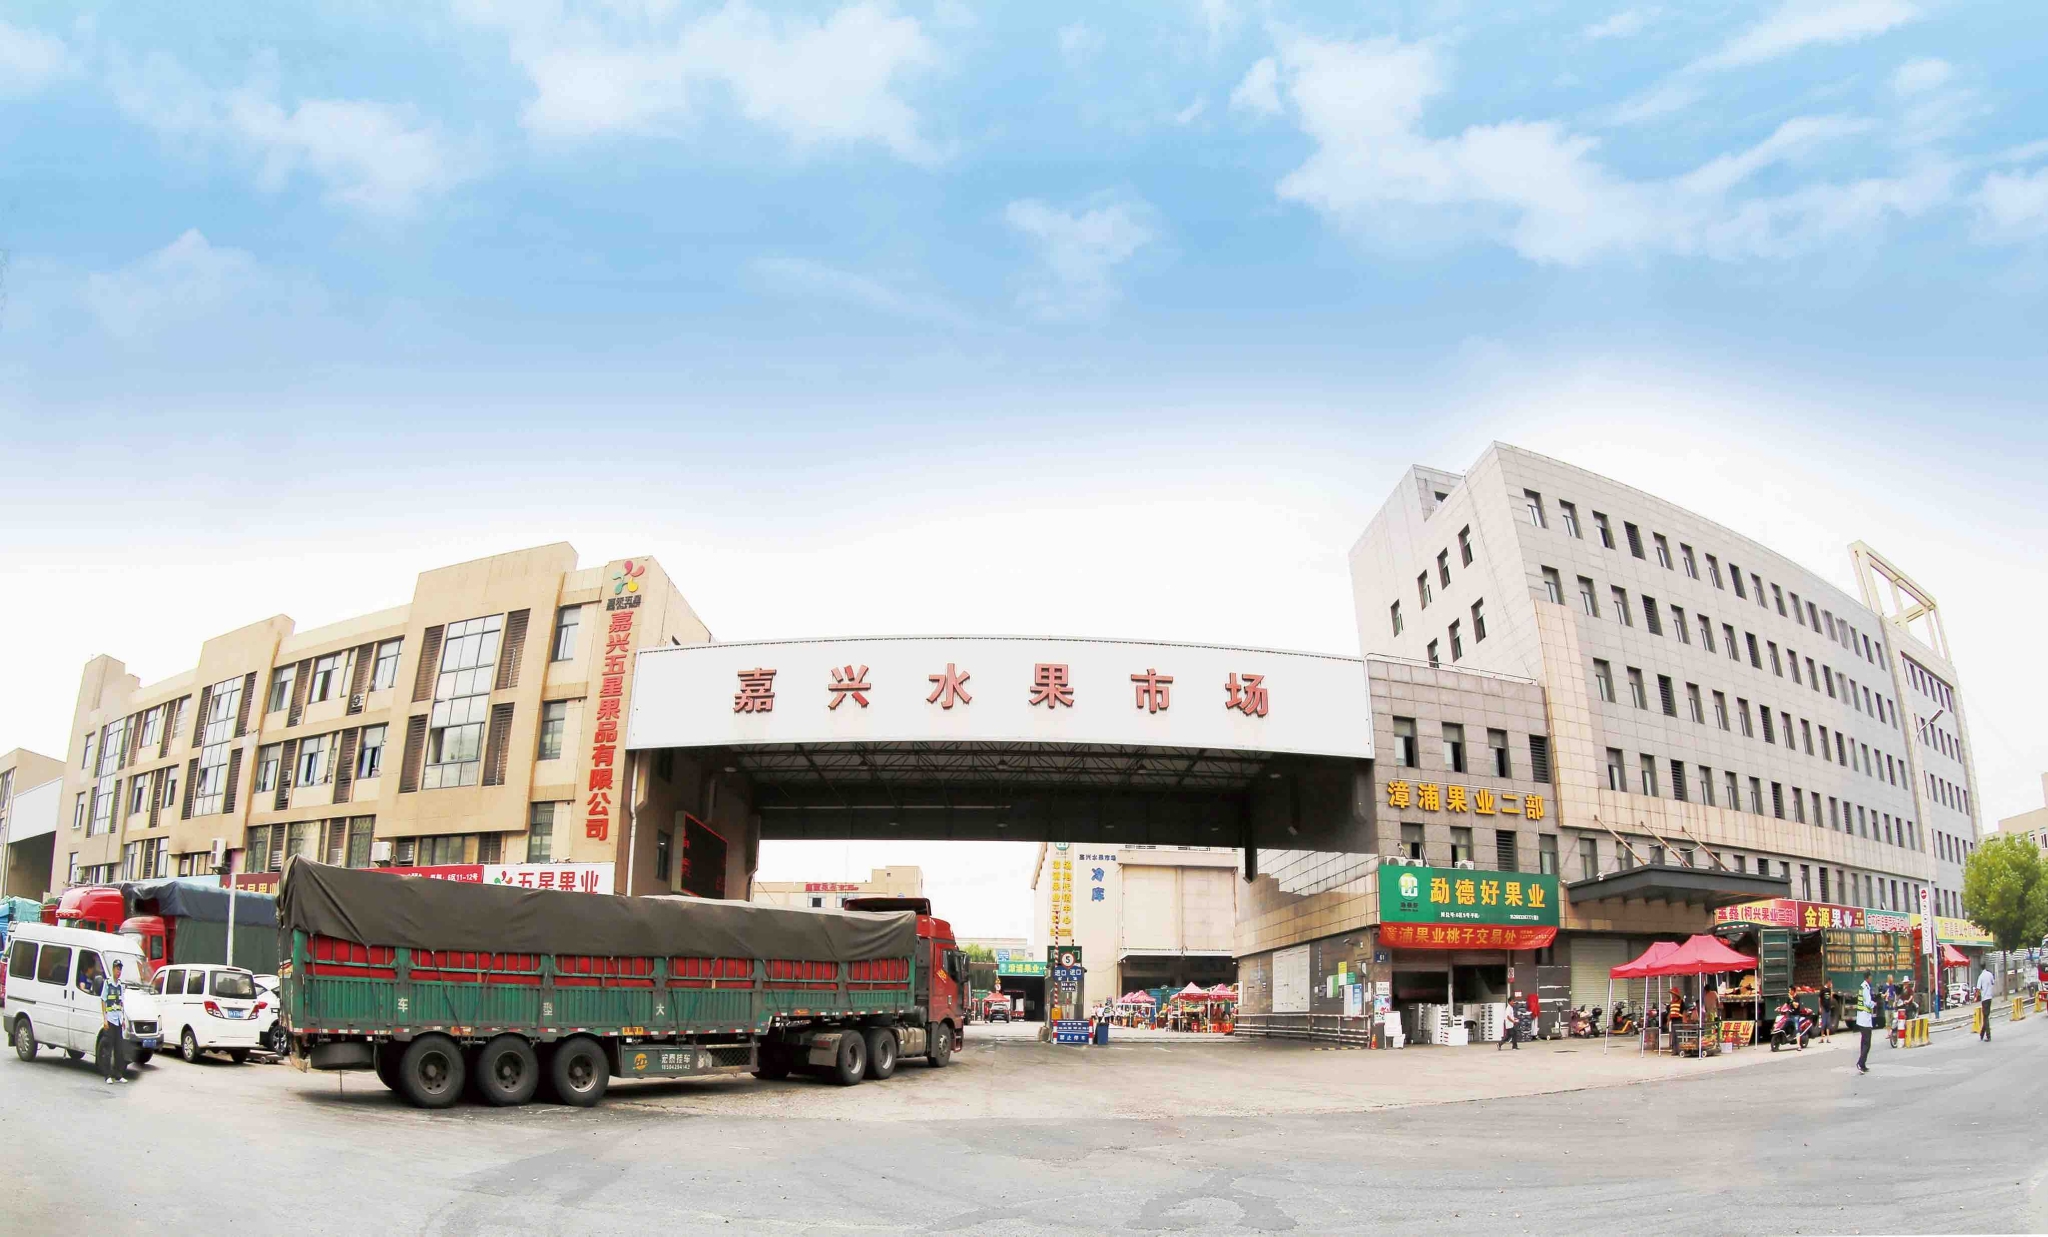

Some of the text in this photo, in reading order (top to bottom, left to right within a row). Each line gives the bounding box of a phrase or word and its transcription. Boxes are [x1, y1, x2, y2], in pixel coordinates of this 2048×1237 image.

[733, 663, 1269, 716] 嘉兴水果市场
[585, 610, 634, 841] 嘉兴五星果品有限公司
[1387, 780, 1545, 821] 漳浦果业二部
[518, 870, 599, 894] 五星果业
[1091, 867, 1105, 902] 冷库
[1430, 877, 1546, 908] 勐德好果业
[1804, 906, 1852, 929] 金源果业
[1384, 925, 1517, 945] 漳浦果业桃子交易处
[397, 997, 409, 1013] 车
[656, 1003, 665, 1016] 大
